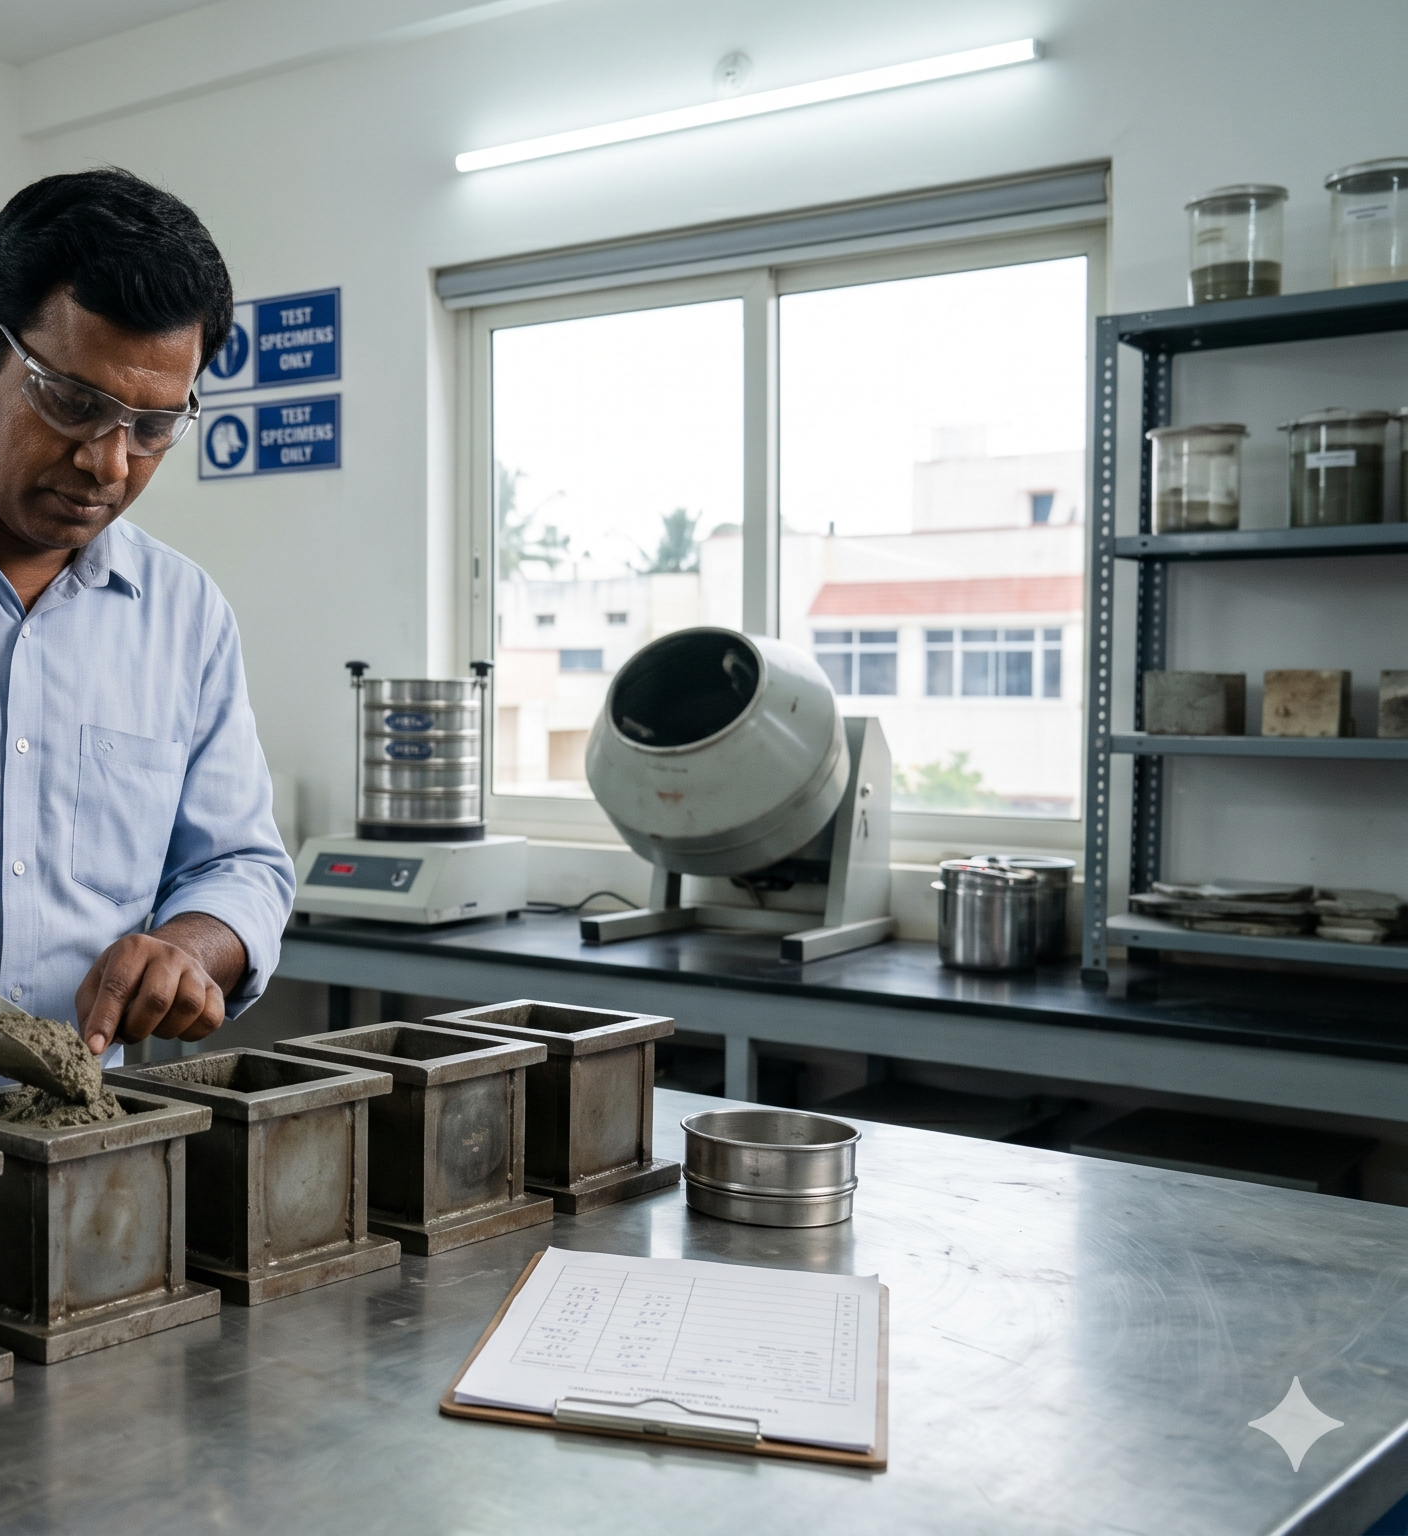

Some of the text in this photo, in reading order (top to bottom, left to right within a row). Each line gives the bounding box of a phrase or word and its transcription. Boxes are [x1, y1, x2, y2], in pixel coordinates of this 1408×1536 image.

[279, 306, 313, 327] TEST
[259, 325, 334, 352] SPECIMENS
[279, 350, 314, 371] ONLY
[280, 405, 312, 425] TEST
[260, 423, 334, 447] SPECIMENS
[280, 446, 314, 464] ONLY
